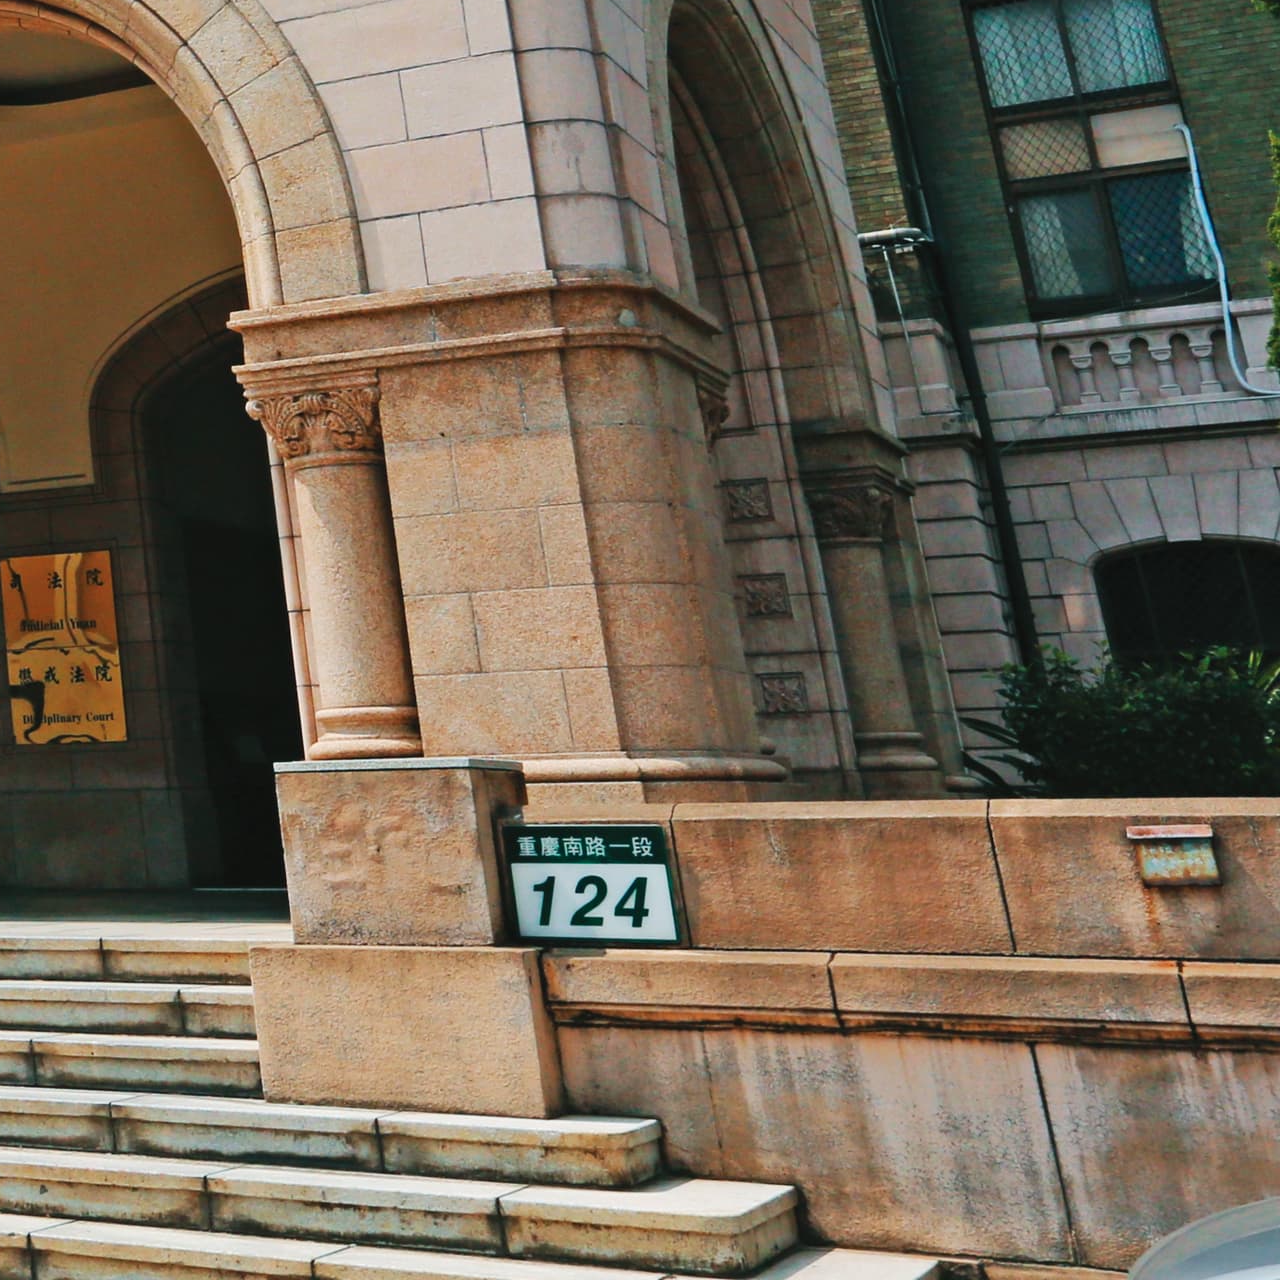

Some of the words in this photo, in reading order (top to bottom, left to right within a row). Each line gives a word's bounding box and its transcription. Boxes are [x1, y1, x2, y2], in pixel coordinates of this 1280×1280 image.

[10, 567, 104, 592] 司法院
[22, 714, 82, 726] Diiplinary
[86, 711, 114, 722] Court
[517, 836, 654, 857] 重慶南路一段
[532, 874, 650, 929] 124
